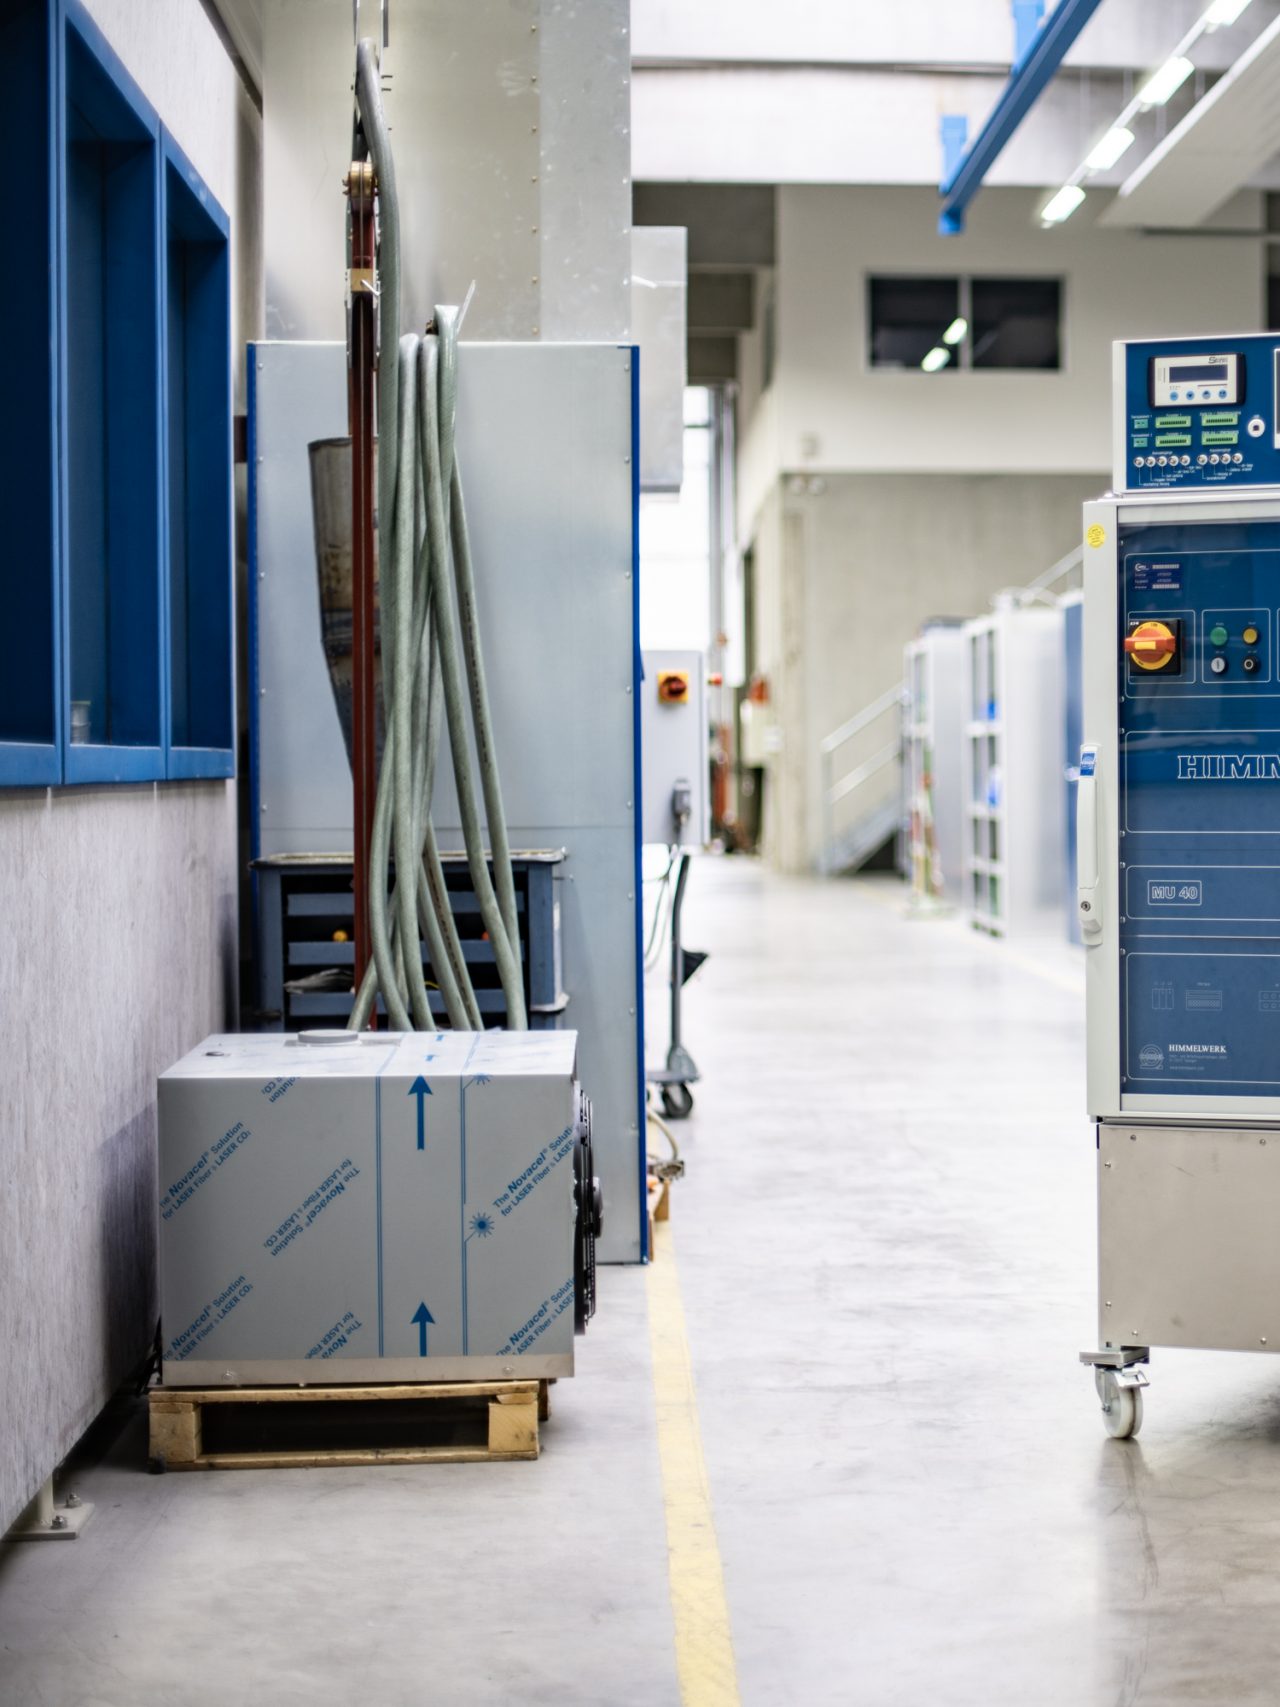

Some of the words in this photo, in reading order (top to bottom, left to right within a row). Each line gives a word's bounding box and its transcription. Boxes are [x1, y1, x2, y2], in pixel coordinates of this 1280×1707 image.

[1152, 886, 1176, 900] MU
[1178, 886, 1198, 900] 40
[1168, 1044, 1227, 1054] HIMMELWERK
[269, 1077, 296, 1103] olution
[210, 1122, 244, 1154] Solution
[340, 1158, 352, 1170] for
[343, 1168, 360, 1182] The
[493, 1193, 510, 1208] The
[549, 1126, 573, 1151] Soluti
[162, 1208, 174, 1220] for
[172, 1186, 195, 1210] LASER
[193, 1169, 212, 1188] Fiber
[215, 1142, 239, 1166] LASER
[319, 1169, 342, 1192] LASER
[501, 1204, 513, 1216] for
[511, 1182, 535, 1206] LASER
[532, 1166, 551, 1185] Fiber
[302, 1191, 321, 1209] Fiber
[276, 1213, 299, 1236] LASER
[270, 1225, 304, 1256] Solution
[212, 1275, 246, 1308] Solution
[550, 1277, 575, 1303] Soluti
[196, 1323, 215, 1341] Fiber
[217, 1295, 240, 1319] LASER
[342, 1311, 354, 1323] for
[345, 1320, 362, 1335] The
[320, 1322, 344, 1345] LASER
[512, 1335, 536, 1356] ASER
[534, 1318, 552, 1336] Fiber
